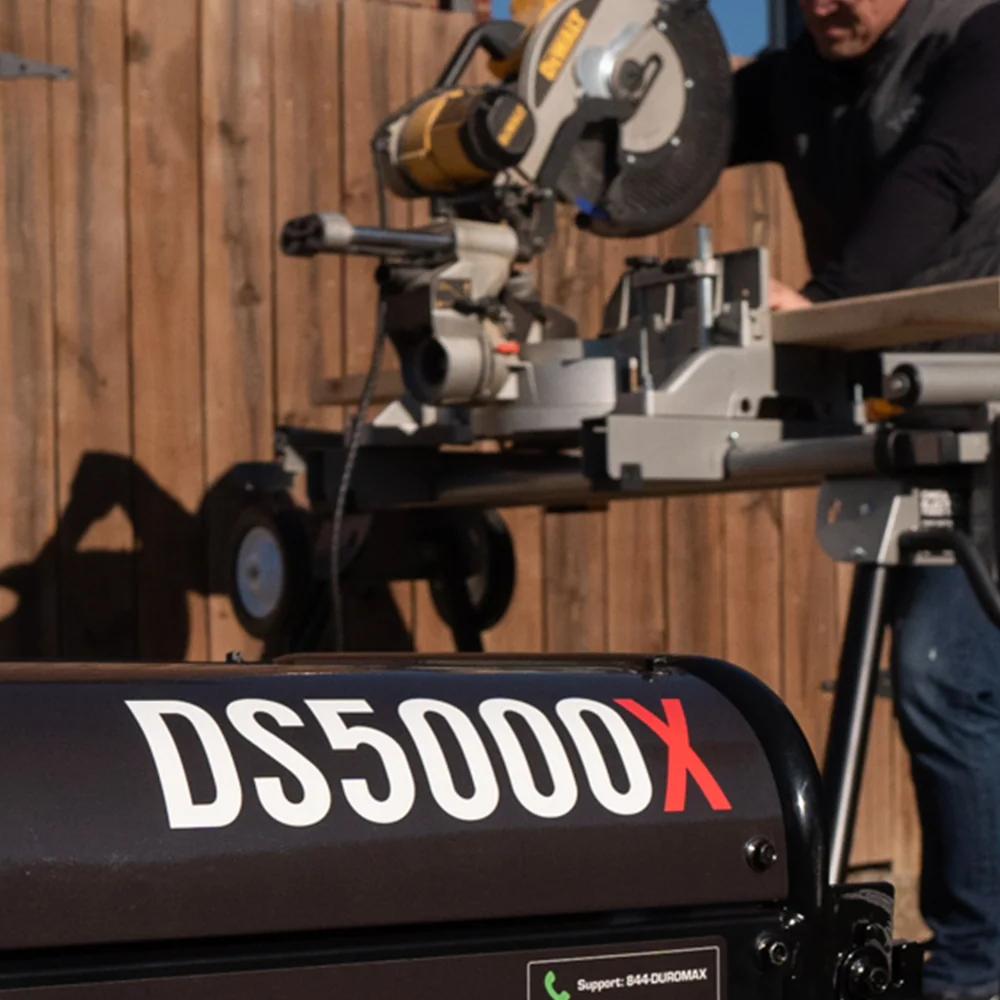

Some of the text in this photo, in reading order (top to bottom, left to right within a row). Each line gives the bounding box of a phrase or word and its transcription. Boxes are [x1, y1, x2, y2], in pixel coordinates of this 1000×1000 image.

[125, 697, 732, 830] DS5000X
[577, 968, 707, 993] Support: 844-DUROMAX
